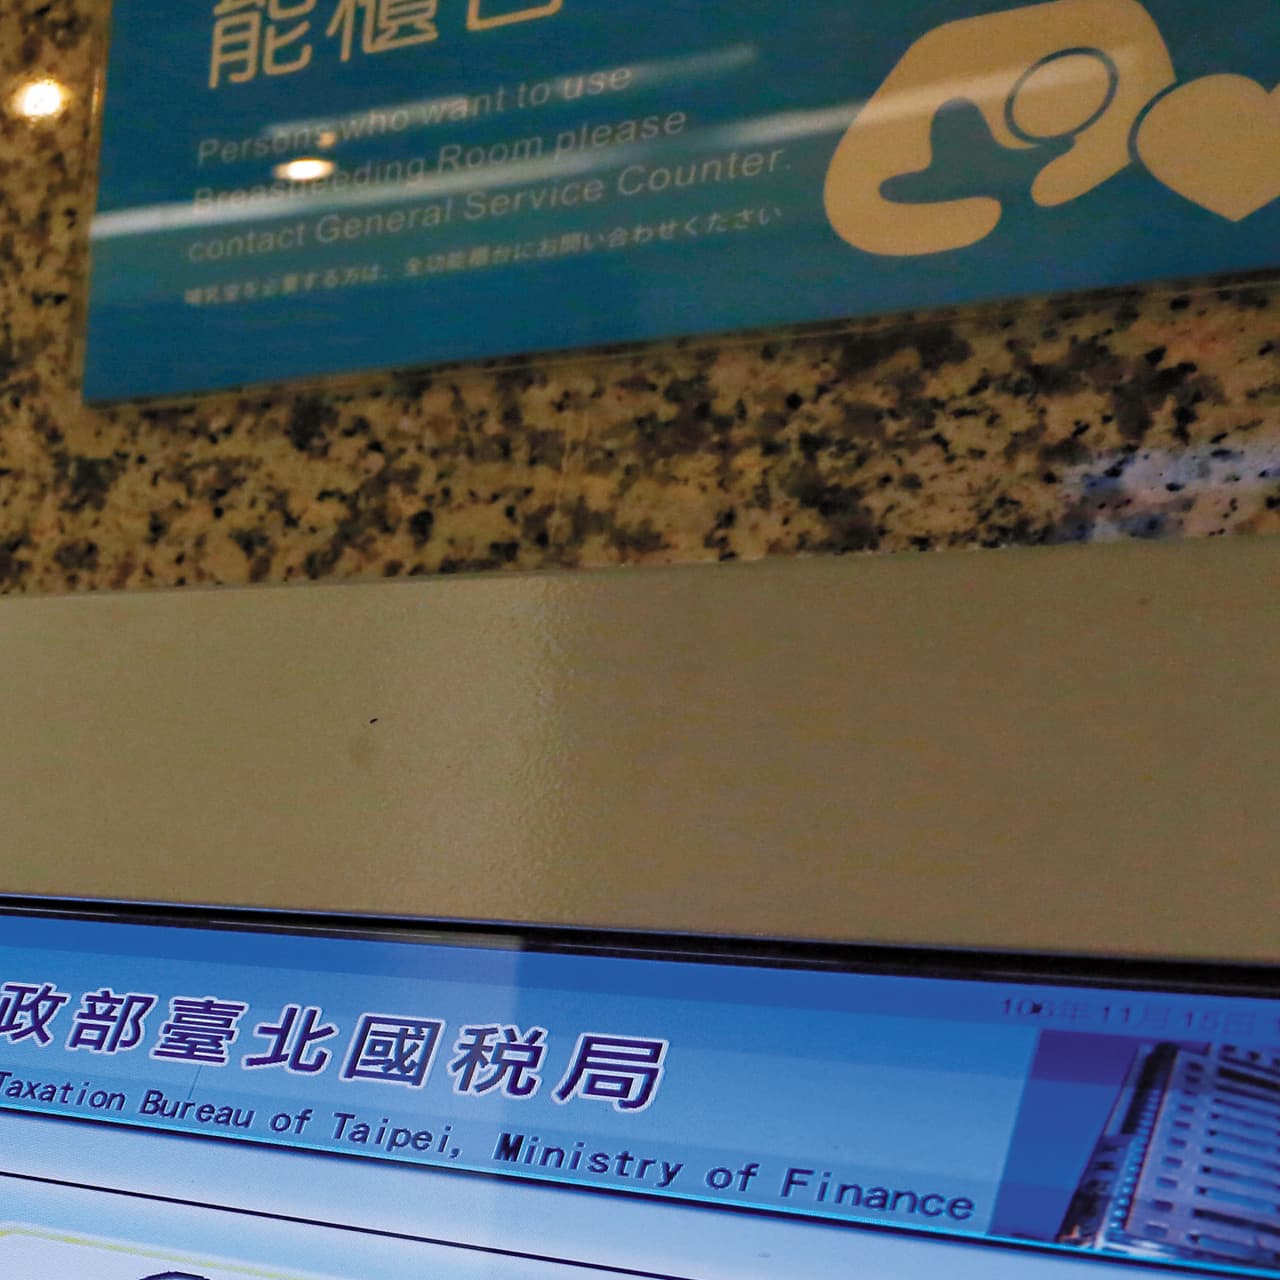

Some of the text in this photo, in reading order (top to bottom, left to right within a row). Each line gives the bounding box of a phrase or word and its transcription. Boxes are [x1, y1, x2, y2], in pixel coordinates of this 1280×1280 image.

[208, 0, 563, 89] 能櫃
[342, 105, 410, 139] who
[420, 88, 505, 125] want
[516, 84, 552, 111] to
[561, 67, 634, 99] use
[440, 136, 542, 173] Room
[554, 110, 688, 159] please
[187, 221, 306, 264] contact
[314, 189, 454, 246] General
[461, 175, 605, 221] Service
[138, 1089, 253, 1130] Bureau
[269, 1107, 311, 1134] of
[333, 1111, 462, 1159] Taipei,
[493, 1132, 684, 1188] Ministry
[705, 1162, 760, 1193] of
[781, 1167, 975, 1221] Finance
